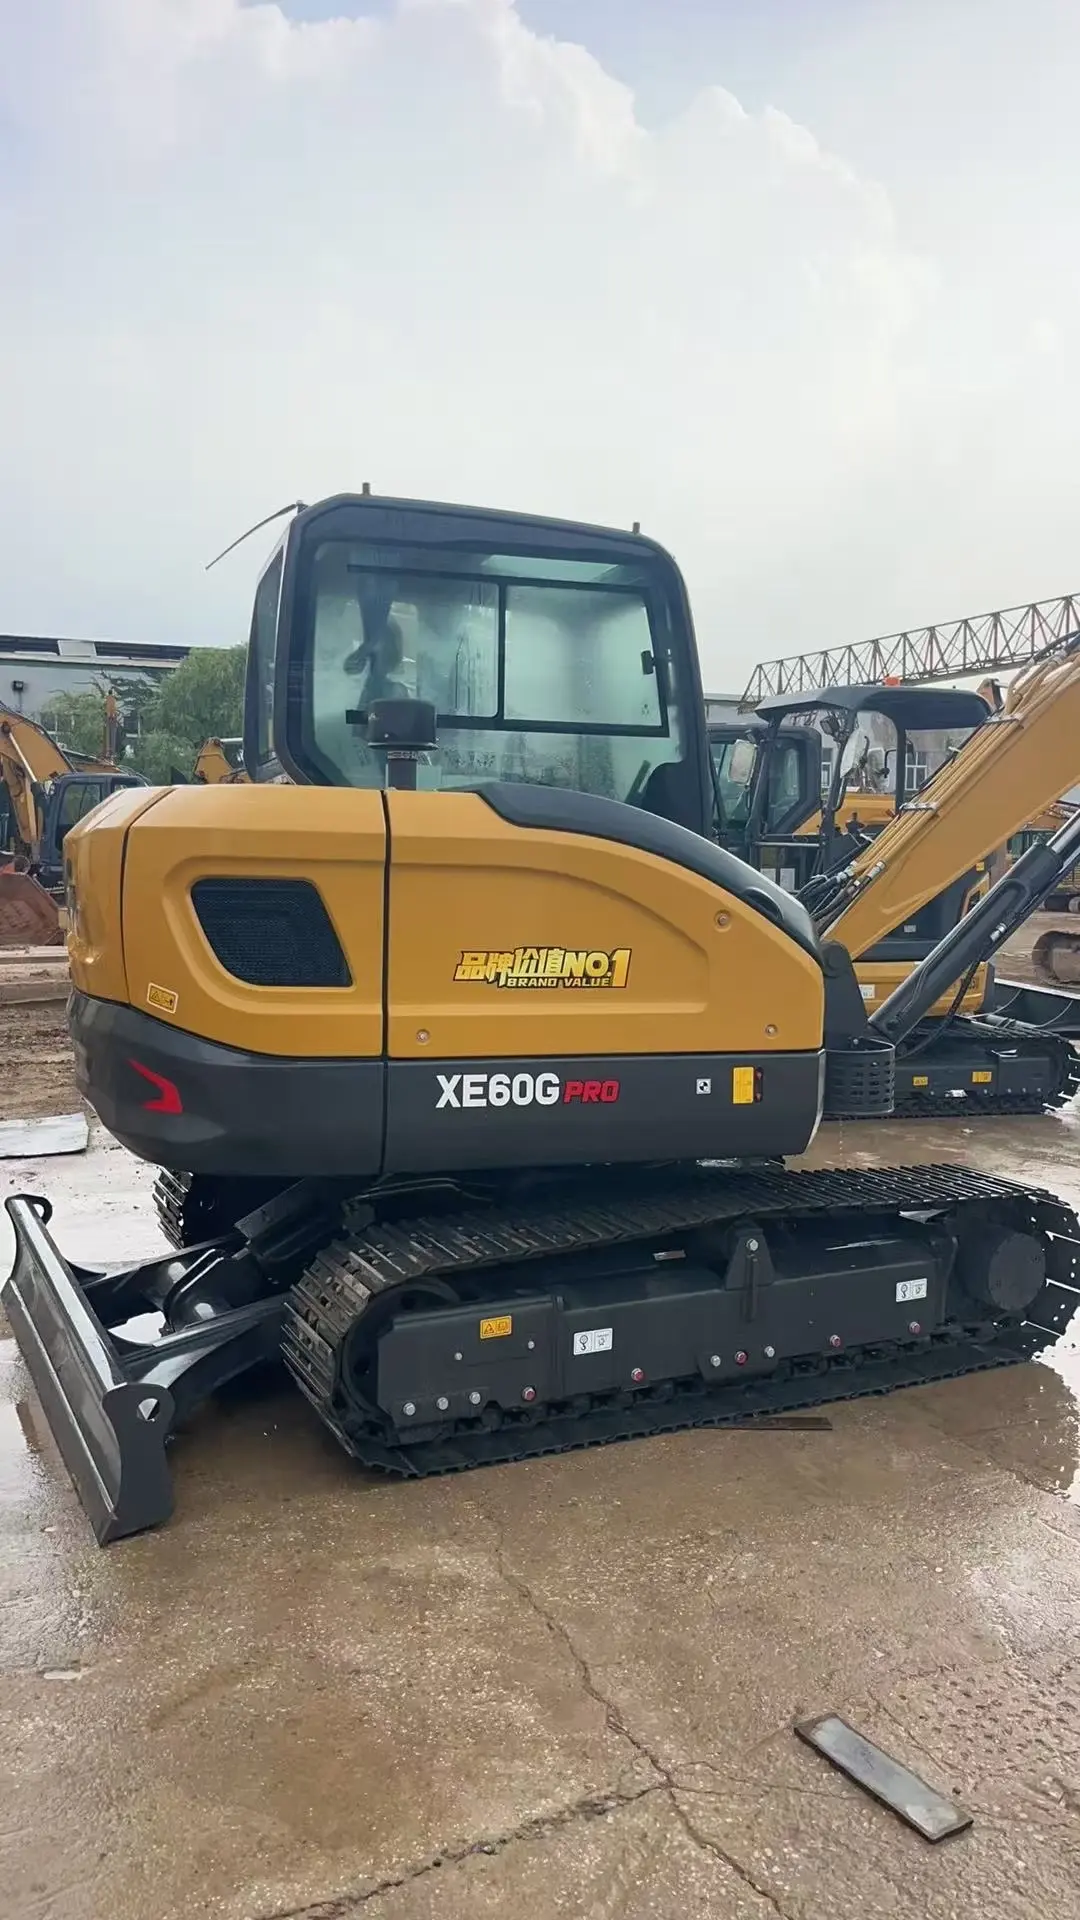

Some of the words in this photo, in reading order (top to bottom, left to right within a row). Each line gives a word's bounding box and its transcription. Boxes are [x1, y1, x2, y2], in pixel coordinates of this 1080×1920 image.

[506, 977, 558, 987] BRAND
[564, 977, 610, 987] VALUE
[435, 1073, 560, 1108] XE60G
[563, 1080, 620, 1103] PRO
